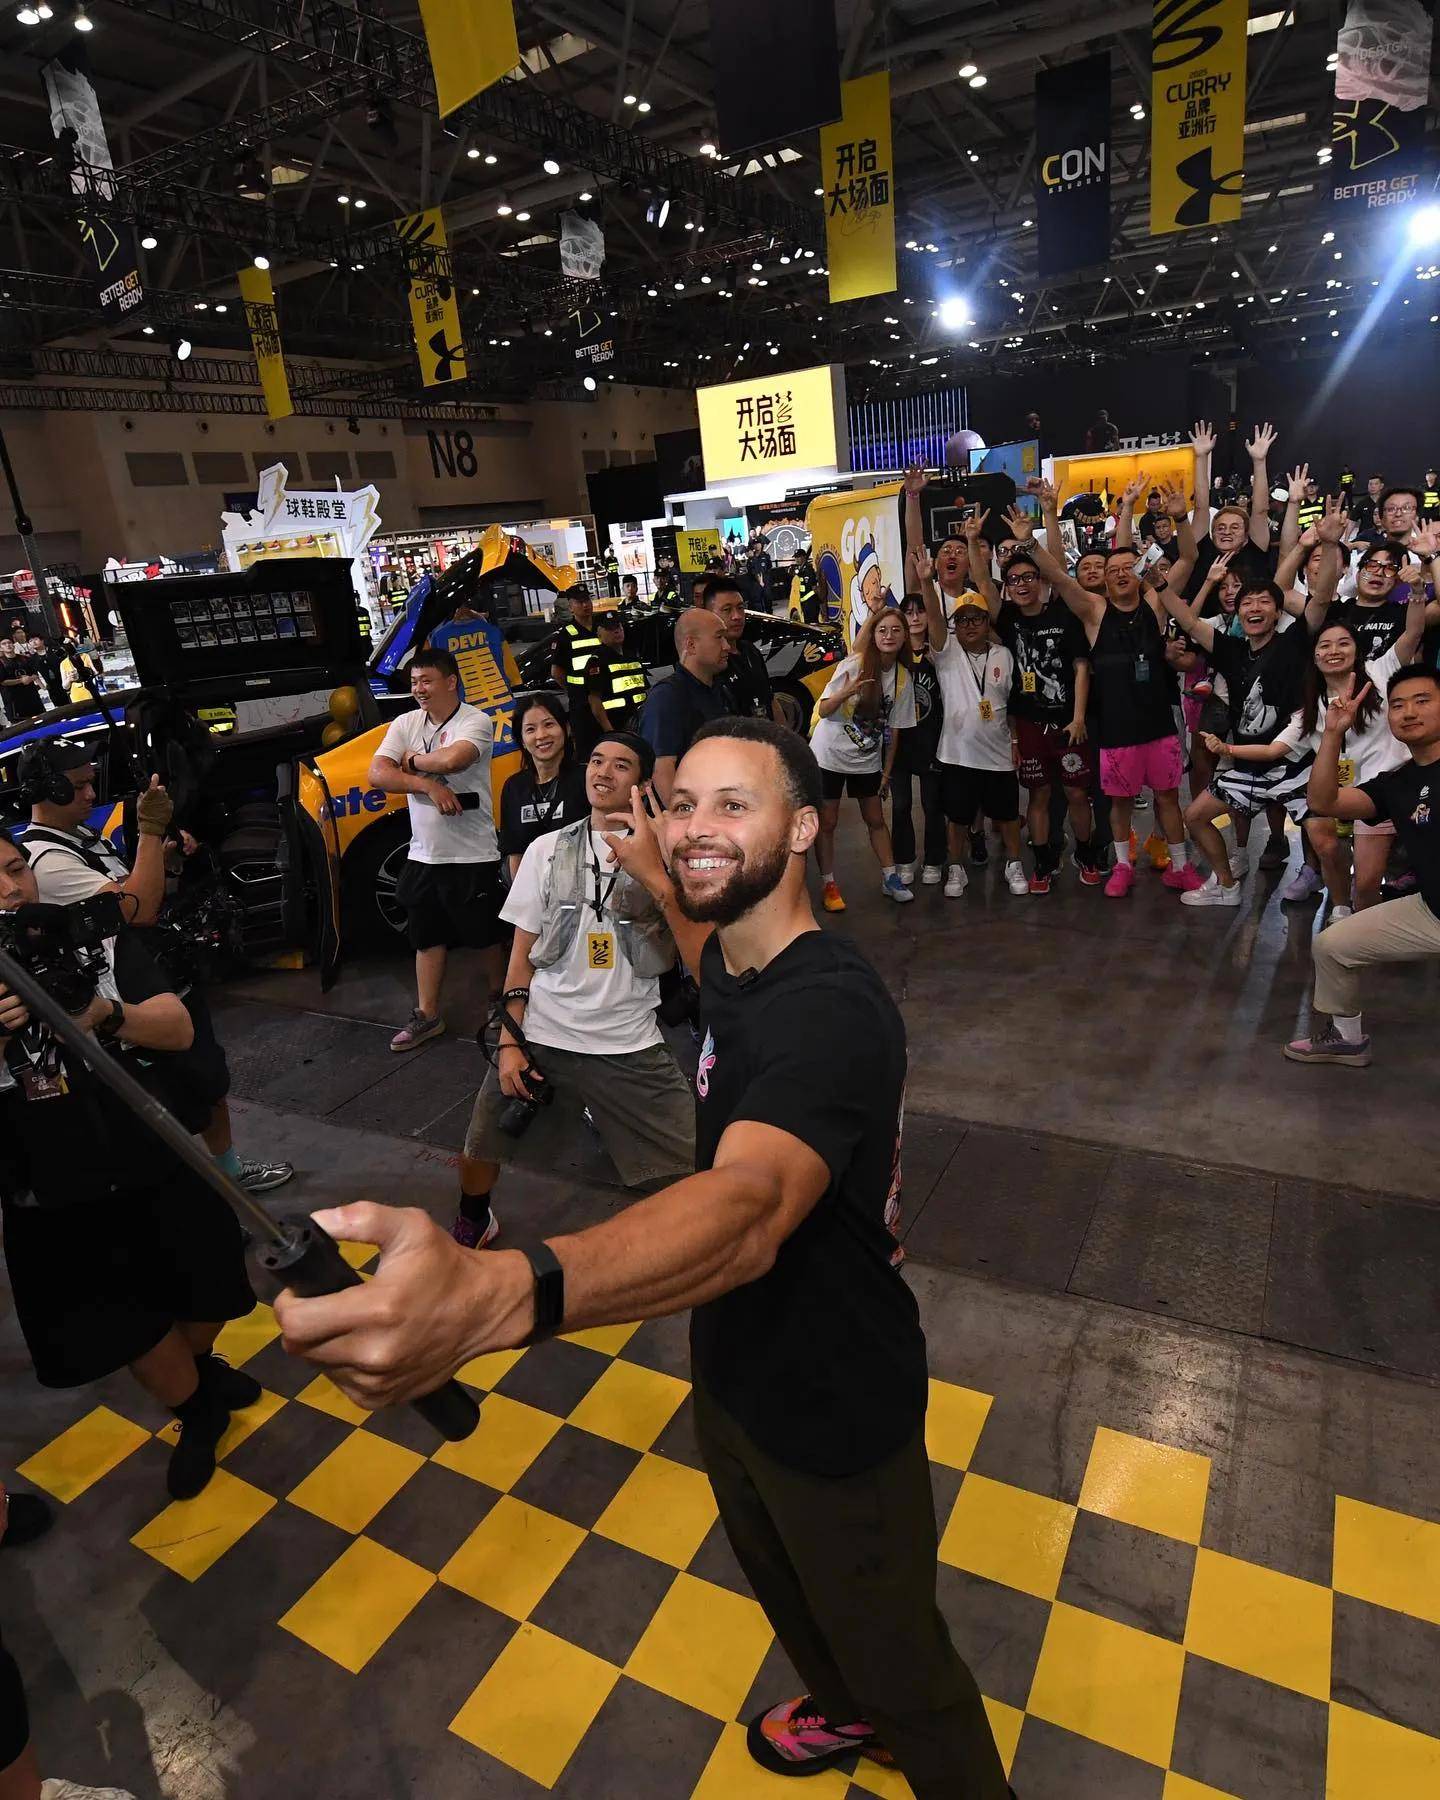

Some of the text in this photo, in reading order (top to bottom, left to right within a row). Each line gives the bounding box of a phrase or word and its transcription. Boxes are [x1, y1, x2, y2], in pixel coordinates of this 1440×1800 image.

[1166, 72, 1232, 103] CURRY
[1177, 115, 1217, 140] 亚洲行
[836, 139, 876, 179] 开启
[1042, 142, 1105, 186] CON
[828, 171, 889, 217] 大场面
[1333, 174, 1419, 200] BETTER GET
[1367, 188, 1417, 209] READY
[99, 269, 139, 307] BETTER GET
[118, 285, 143, 312] READY
[575, 340, 613, 359] BETTER GET
[591, 350, 614, 364] READY
[735, 394, 774, 429] 开启
[426, 429, 478, 479] N8
[738, 424, 796, 462] 大场面
[285, 498, 347, 520] 球鞋殿堂
